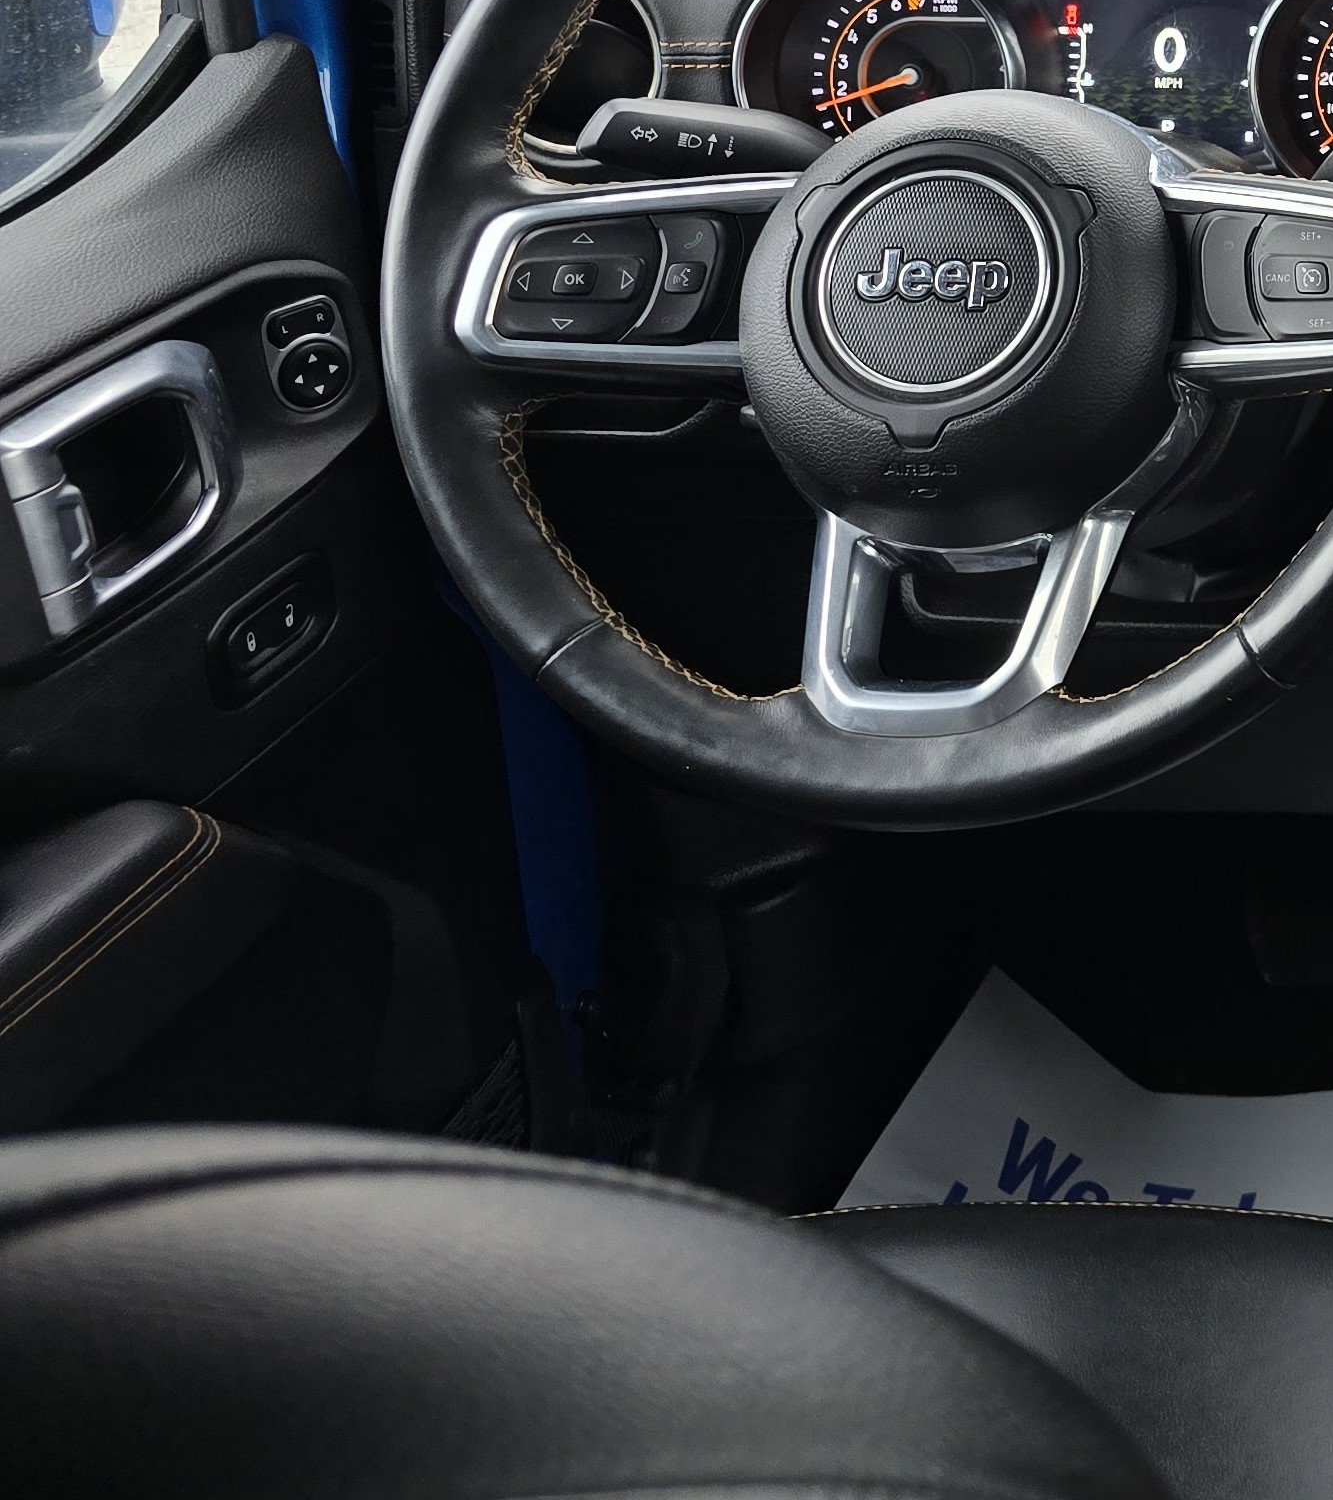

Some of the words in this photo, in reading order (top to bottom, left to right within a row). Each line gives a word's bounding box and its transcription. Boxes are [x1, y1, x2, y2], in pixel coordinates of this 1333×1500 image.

[866, 8, 878, 24] 5
[847, 29, 858, 44] 4
[1153, 27, 1187, 73] 0
[838, 54, 849, 69] 3
[837, 81, 848, 97] 2
[1154, 77, 1183, 89] MPH
[846, 107, 852, 121] 1
[564, 272, 586, 286] OK
[857, 248, 1010, 311] Jeep
[1265, 274, 1291, 283] CANC
[316, 312, 324, 322] R
[281, 325, 289, 335] L
